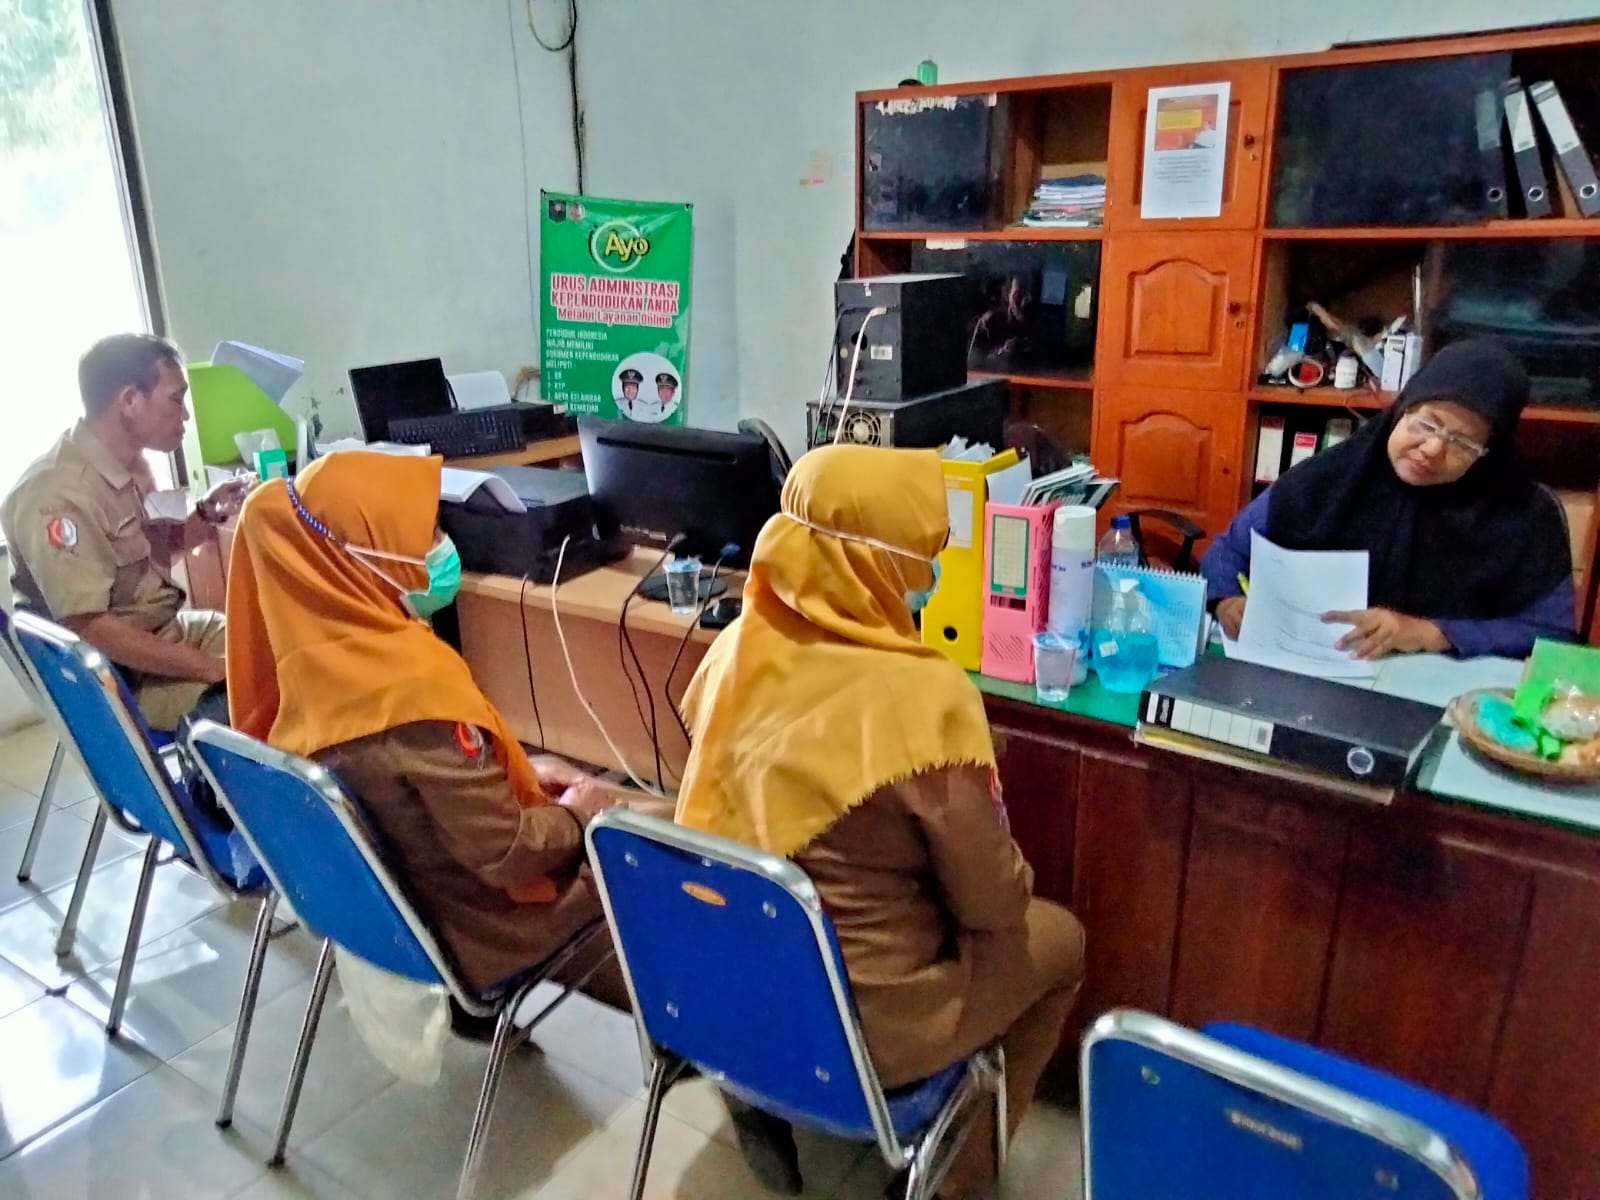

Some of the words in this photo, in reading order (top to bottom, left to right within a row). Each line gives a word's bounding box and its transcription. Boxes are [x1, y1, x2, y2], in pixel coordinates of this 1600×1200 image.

[605, 231, 649, 261] Ayo
[551, 274, 586, 291] URUS
[589, 277, 679, 298] ADMINISTRASI
[551, 291, 643, 311] KEPENDUDUKAN
[646, 299, 678, 314] ANDA
[597, 311, 639, 326] Layanan
[577, 330, 608, 340] INDONESIA
